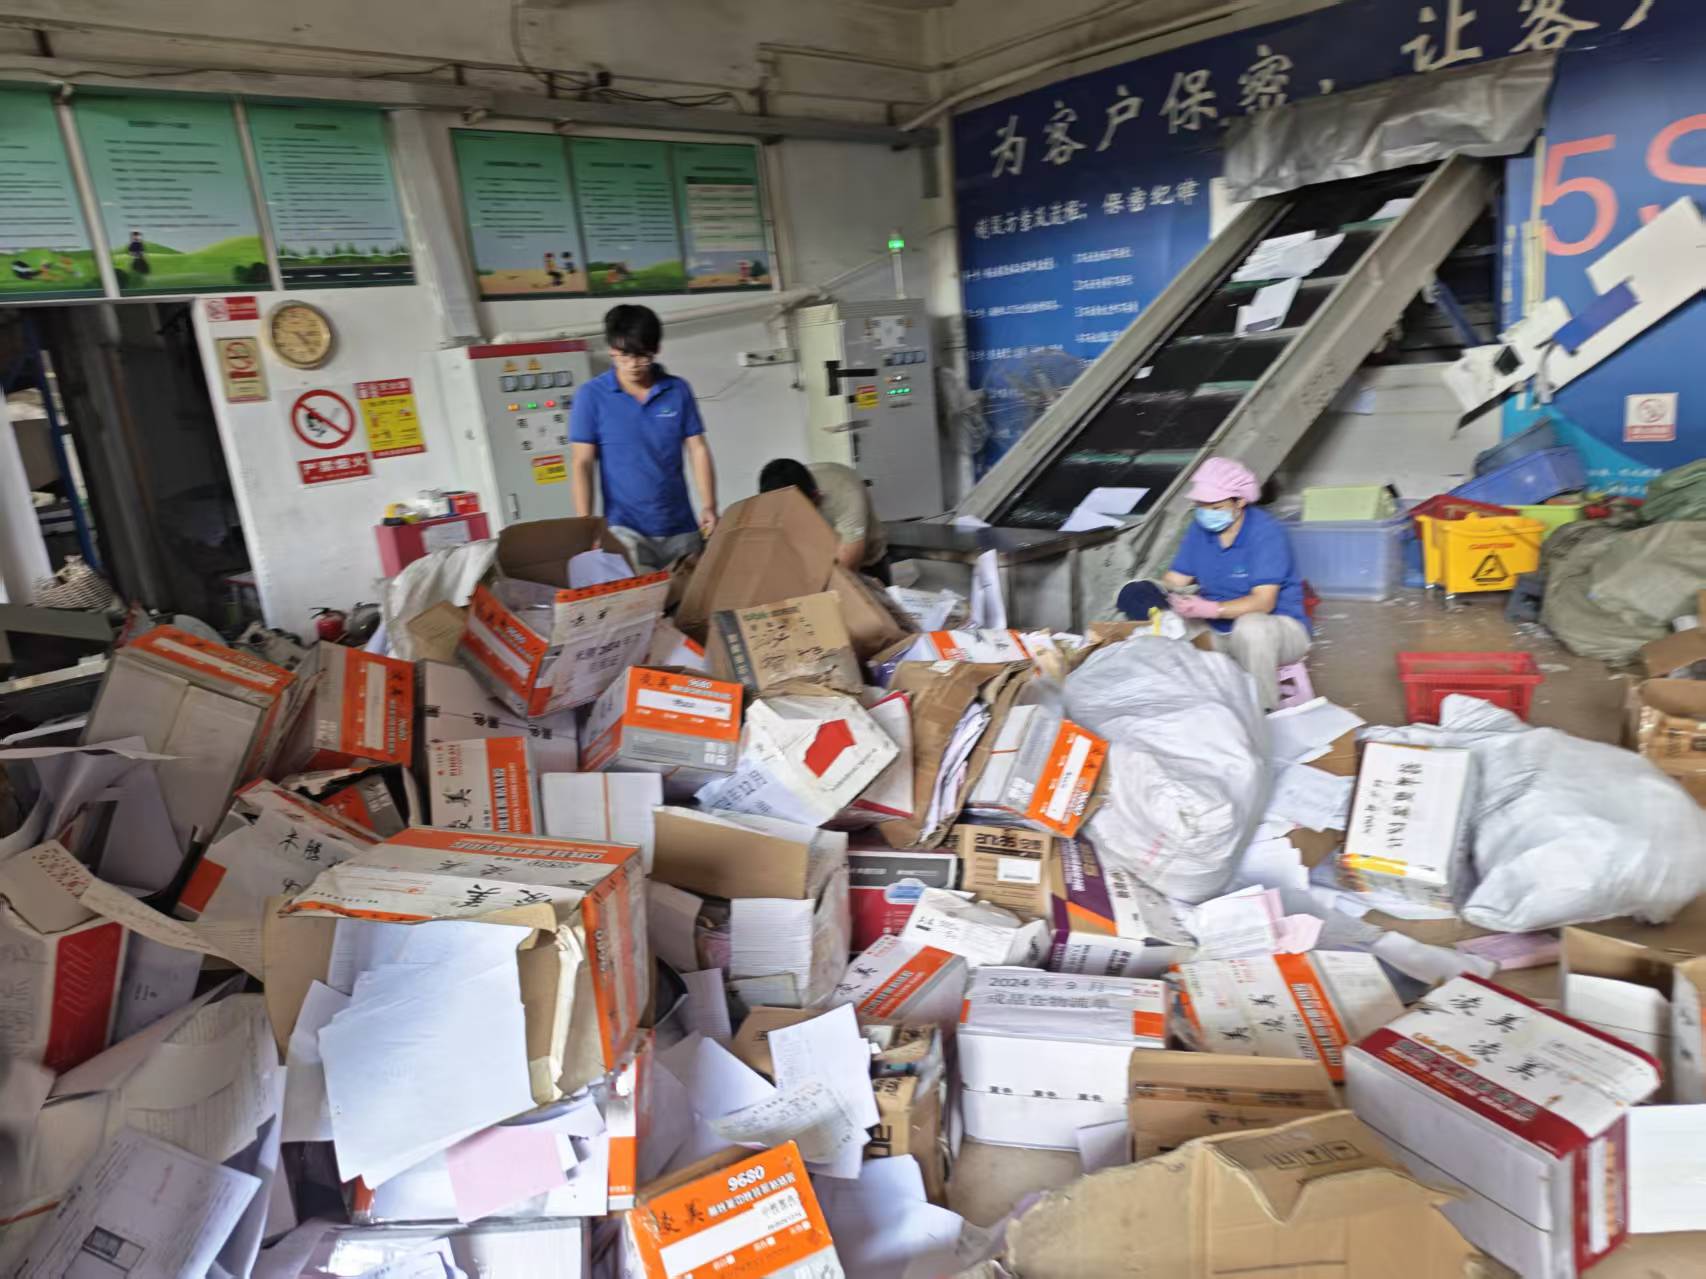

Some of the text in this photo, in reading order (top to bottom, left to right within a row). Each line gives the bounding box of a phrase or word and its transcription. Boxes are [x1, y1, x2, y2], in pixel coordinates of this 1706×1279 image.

[988, 977, 1030, 988] 2024
[1037, 977, 1056, 990] 年
[1065, 981, 1078, 990] 9
